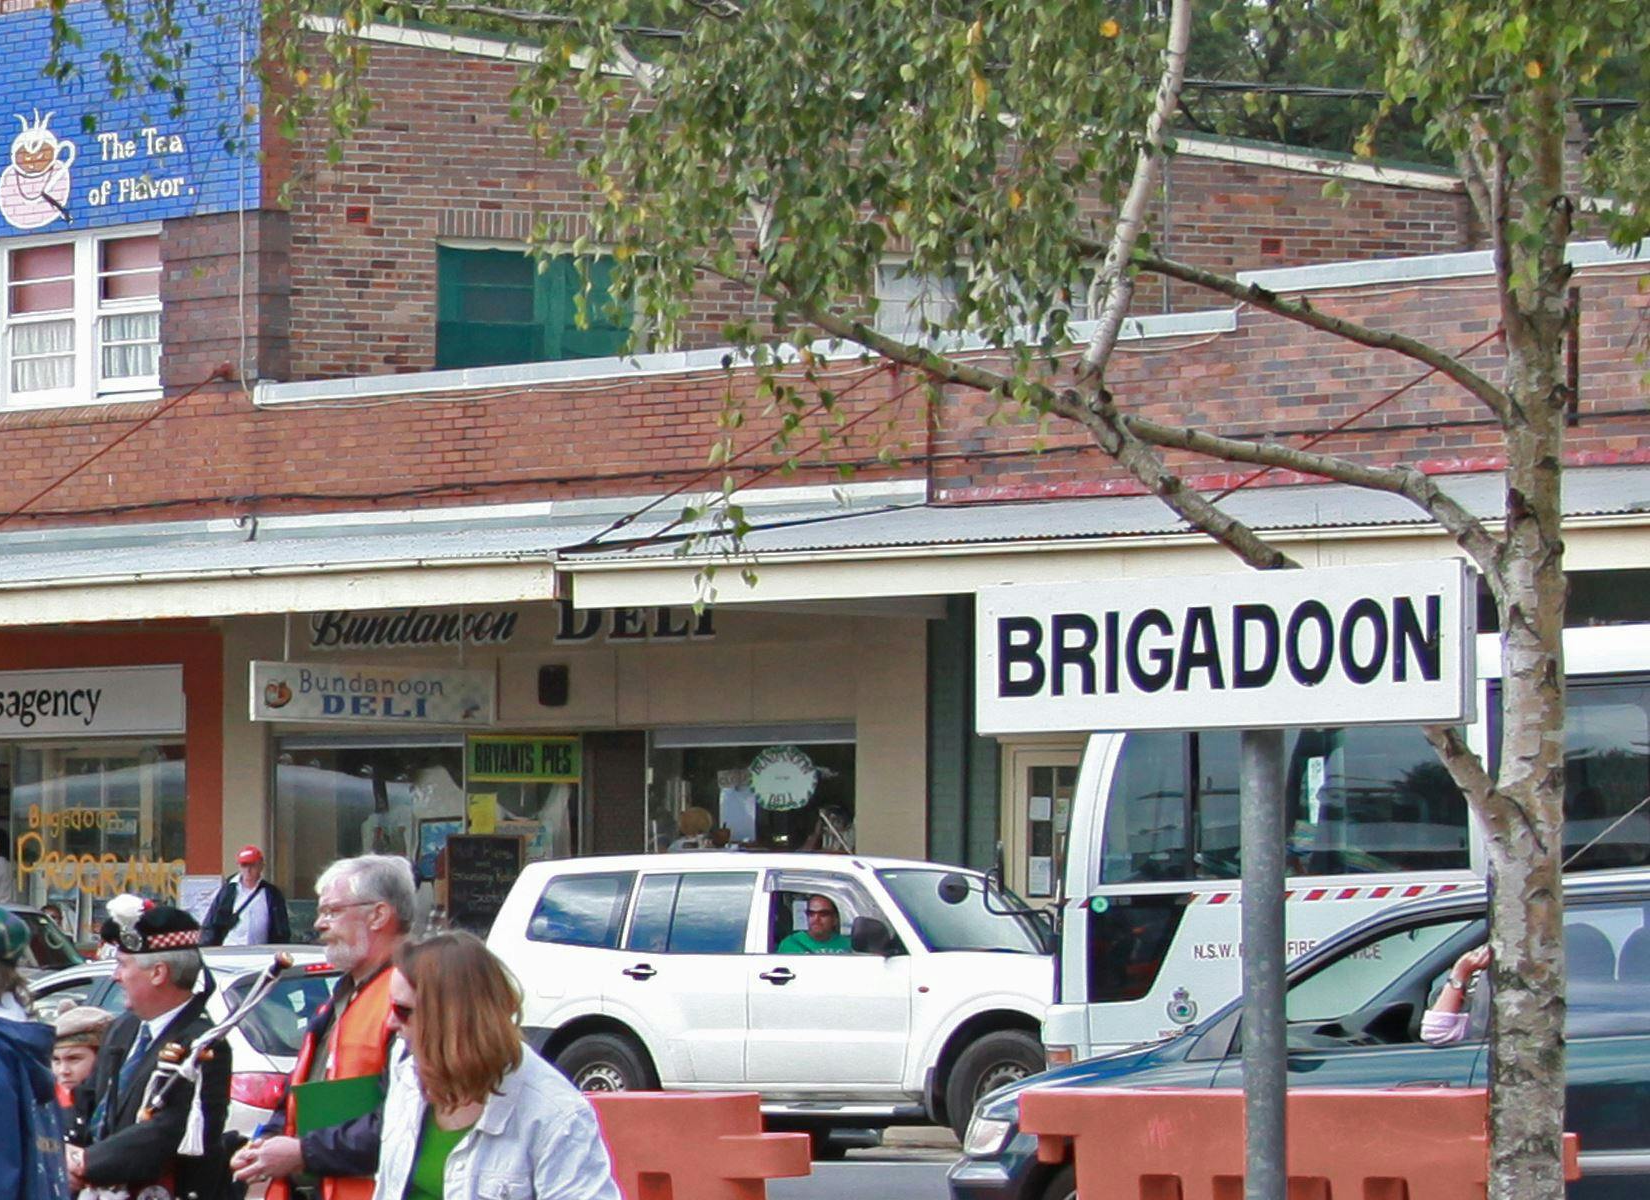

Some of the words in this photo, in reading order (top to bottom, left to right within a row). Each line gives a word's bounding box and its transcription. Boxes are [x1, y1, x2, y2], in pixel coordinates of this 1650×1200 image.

[96, 131, 137, 161] The
[140, 126, 185, 156] Tea
[87, 179, 112, 207] of
[309, 607, 520, 649] Bundanoon
[553, 600, 718, 644] DELI
[996, 594, 1442, 699] BRIGADOON
[299, 668, 444, 695] Bundanoon
[322, 694, 427, 718] DELI
[474, 742, 535, 774] BRYANTS
[541, 743, 573, 775] PIES
[1193, 940, 1235, 960] N.S.W.
